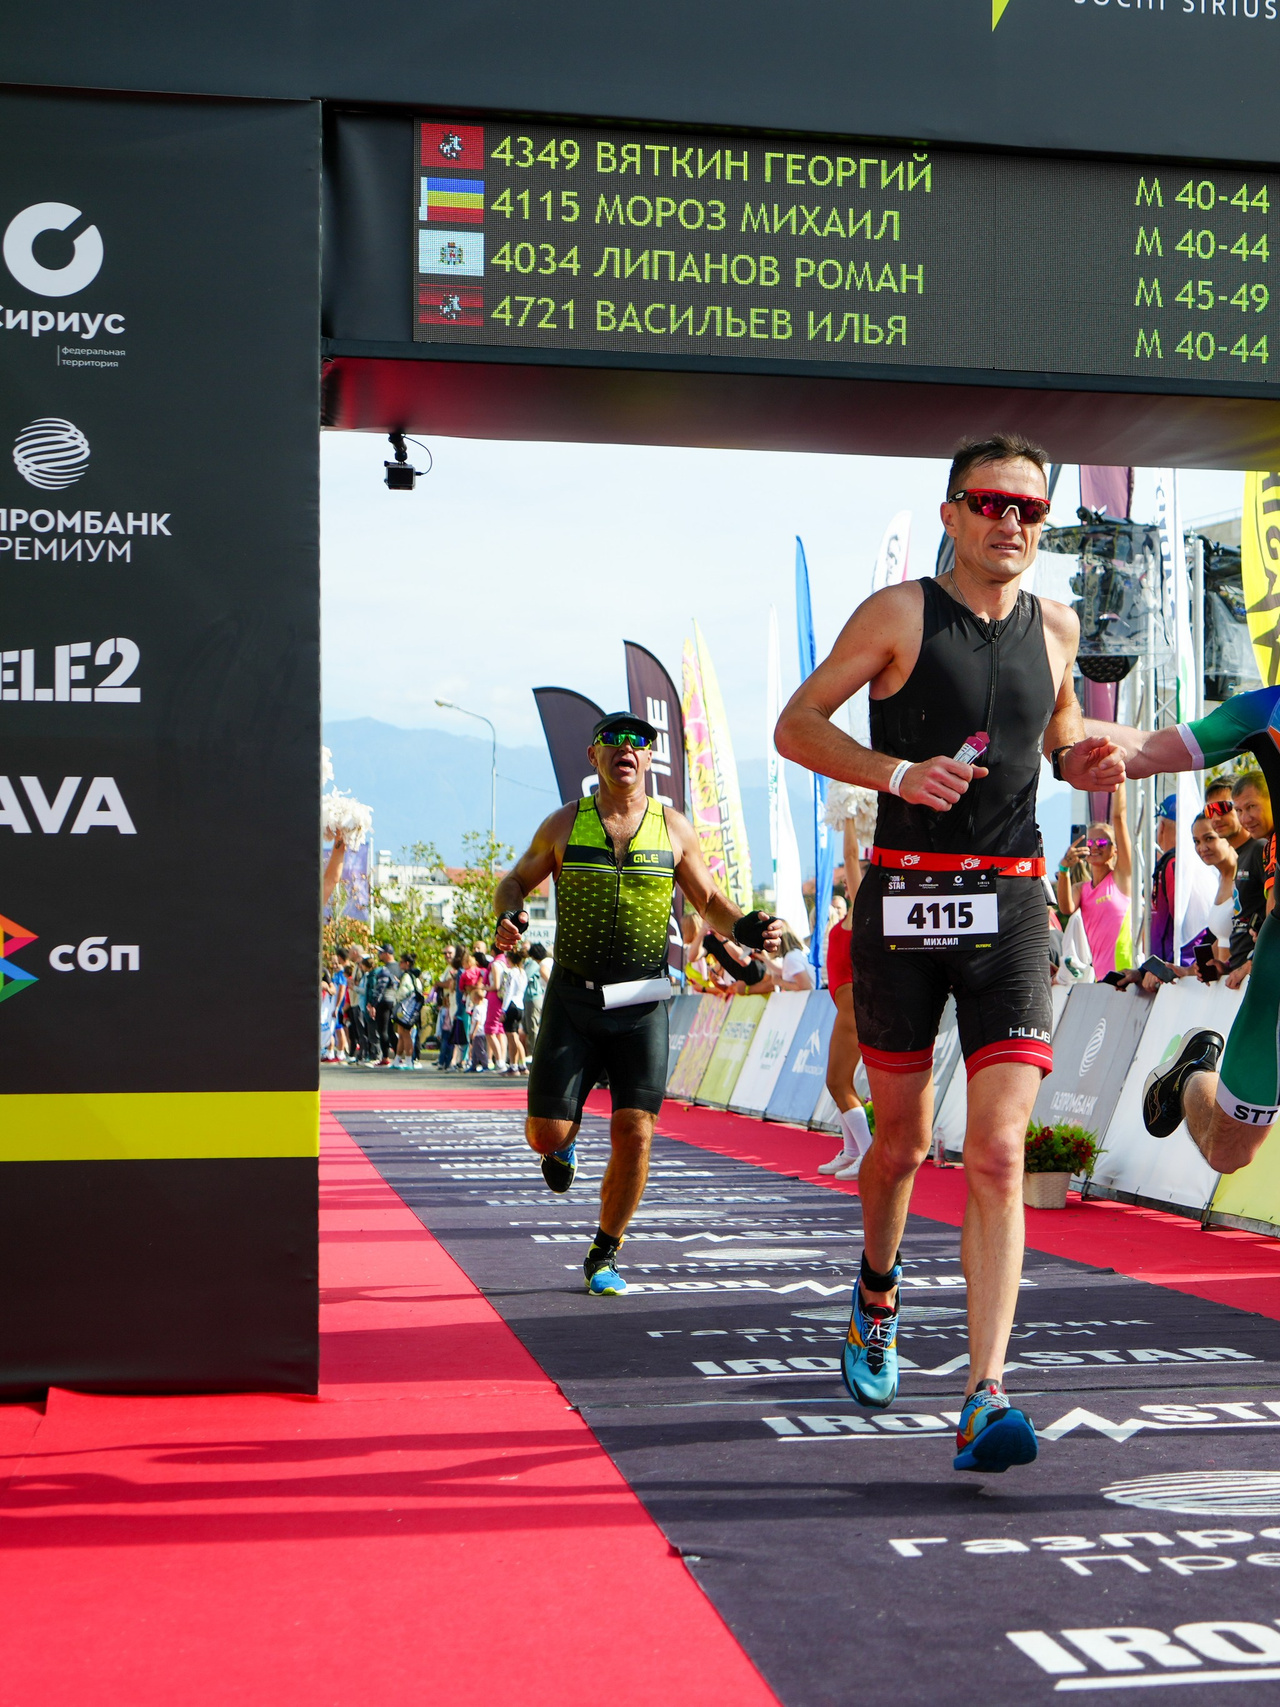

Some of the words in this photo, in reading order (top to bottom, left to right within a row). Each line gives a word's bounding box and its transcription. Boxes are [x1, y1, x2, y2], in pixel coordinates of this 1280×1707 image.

[490, 135, 581, 171] 4349
[595, 141, 749, 183] ВЯТКИН
[764, 153, 934, 194] ГЕОРГИЙ
[1175, 180, 1270, 215] 40-44
[490, 188, 581, 223] 4115
[595, 195, 726, 232] МОРОЗ
[740, 202, 901, 242] МИХАИЛ
[1175, 229, 1270, 264] 40-44
[490, 242, 582, 278] 4034
[593, 246, 780, 287] ЛИПАНОВ
[795, 257, 924, 295] РОМАН
[1175, 279, 1270, 314] 45-49
[0, 304, 126, 340] ириус
[490, 295, 577, 330] 4721
[595, 300, 792, 341] ВАСИЛЬЕВ
[807, 310, 908, 347] ИЛЬЯ
[1175, 330, 1269, 366] 40-44
[61, 345, 126, 357] федеральная
[61, 357, 119, 368] территория
[888, 881, 906, 890] STAR
[907, 902, 974, 930] 4115
[923, 937, 959, 946] МИХАИЛ
[48, 936, 140, 972] сбп
[1008, 1027, 1051, 1044] HUUB
[1233, 1104, 1279, 1125] STT
[1018, 1346, 1257, 1365] STAR
[761, 1411, 964, 1435] IRO
